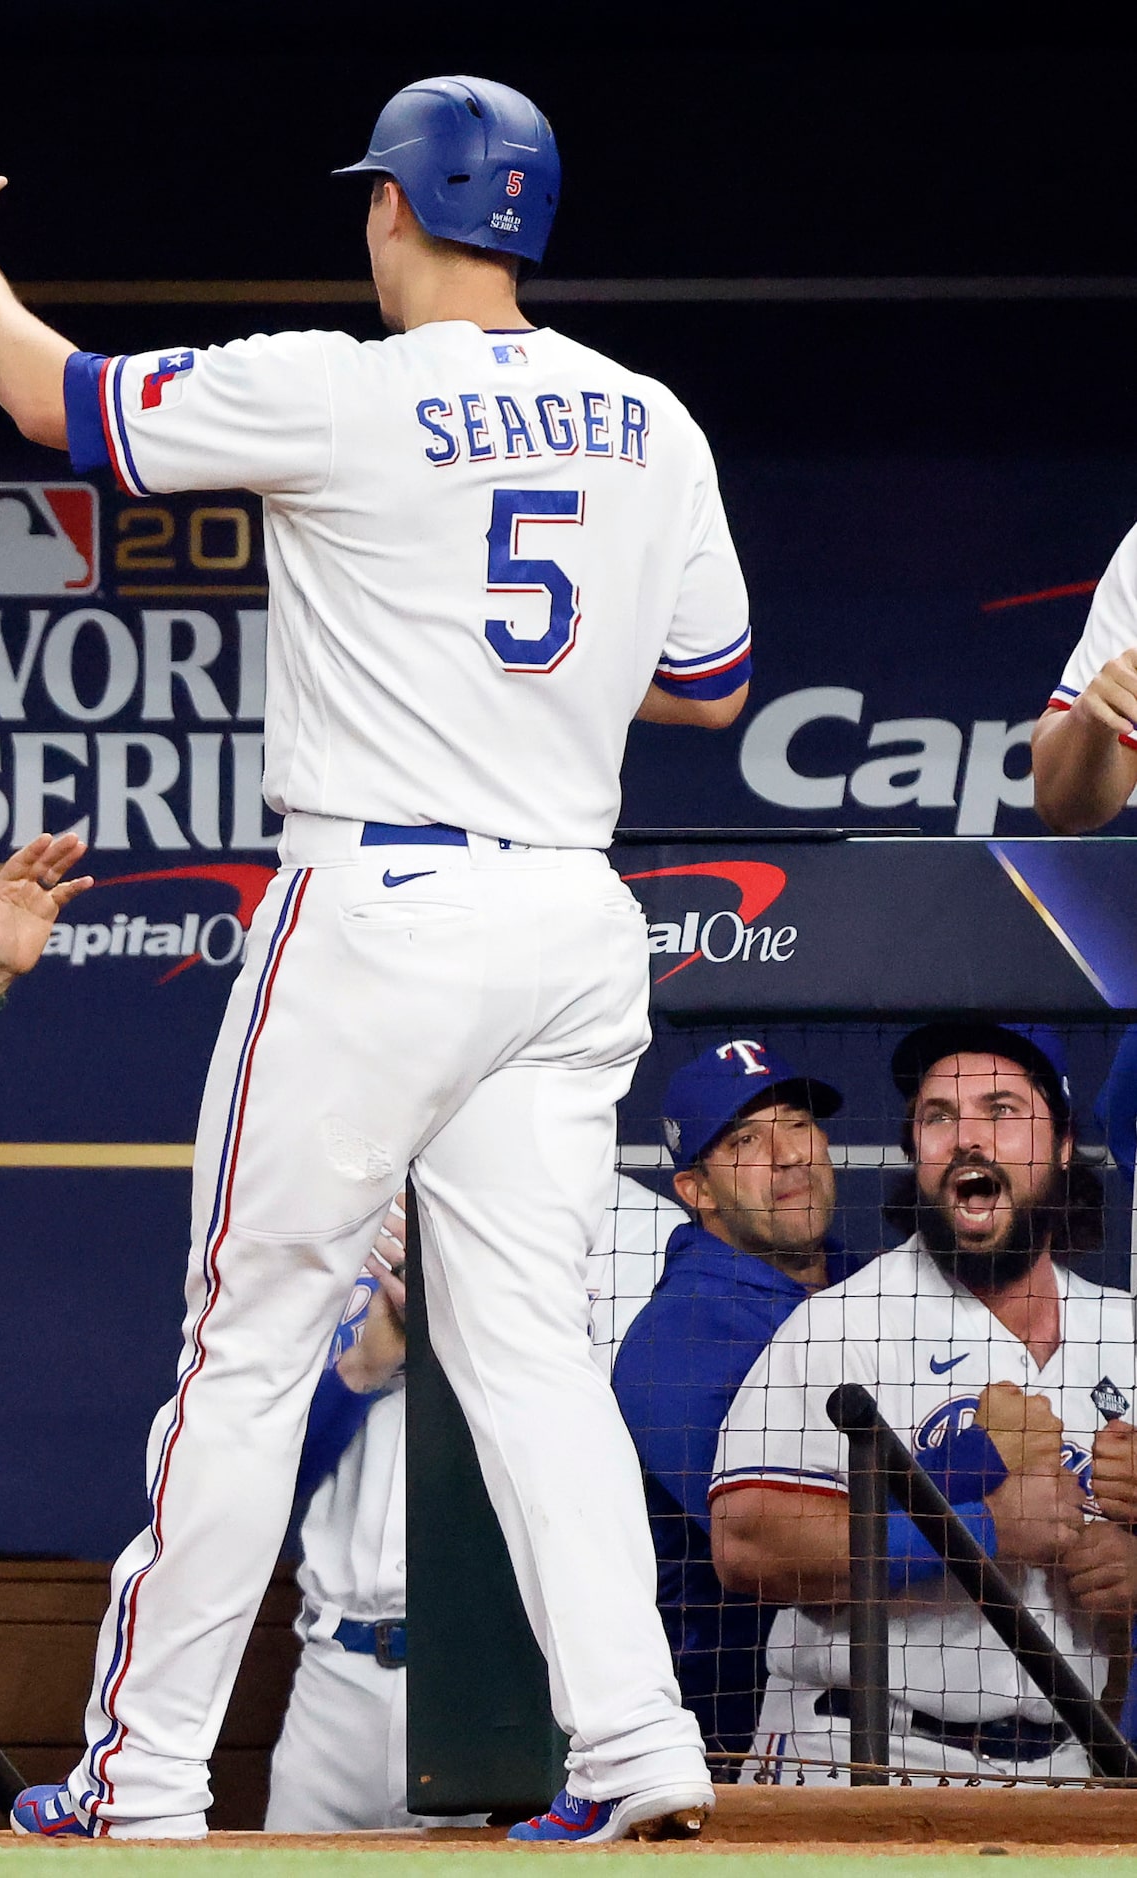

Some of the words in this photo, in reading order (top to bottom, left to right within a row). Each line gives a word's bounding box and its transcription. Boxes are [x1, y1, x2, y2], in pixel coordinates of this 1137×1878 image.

[505, 170, 525, 197] 5
[489, 219, 520, 233] SERIES
[491, 212, 521, 225] WORLD
[415, 391, 649, 467] SEAGER
[483, 488, 585, 673] 5
[716, 1040, 770, 1076] T
